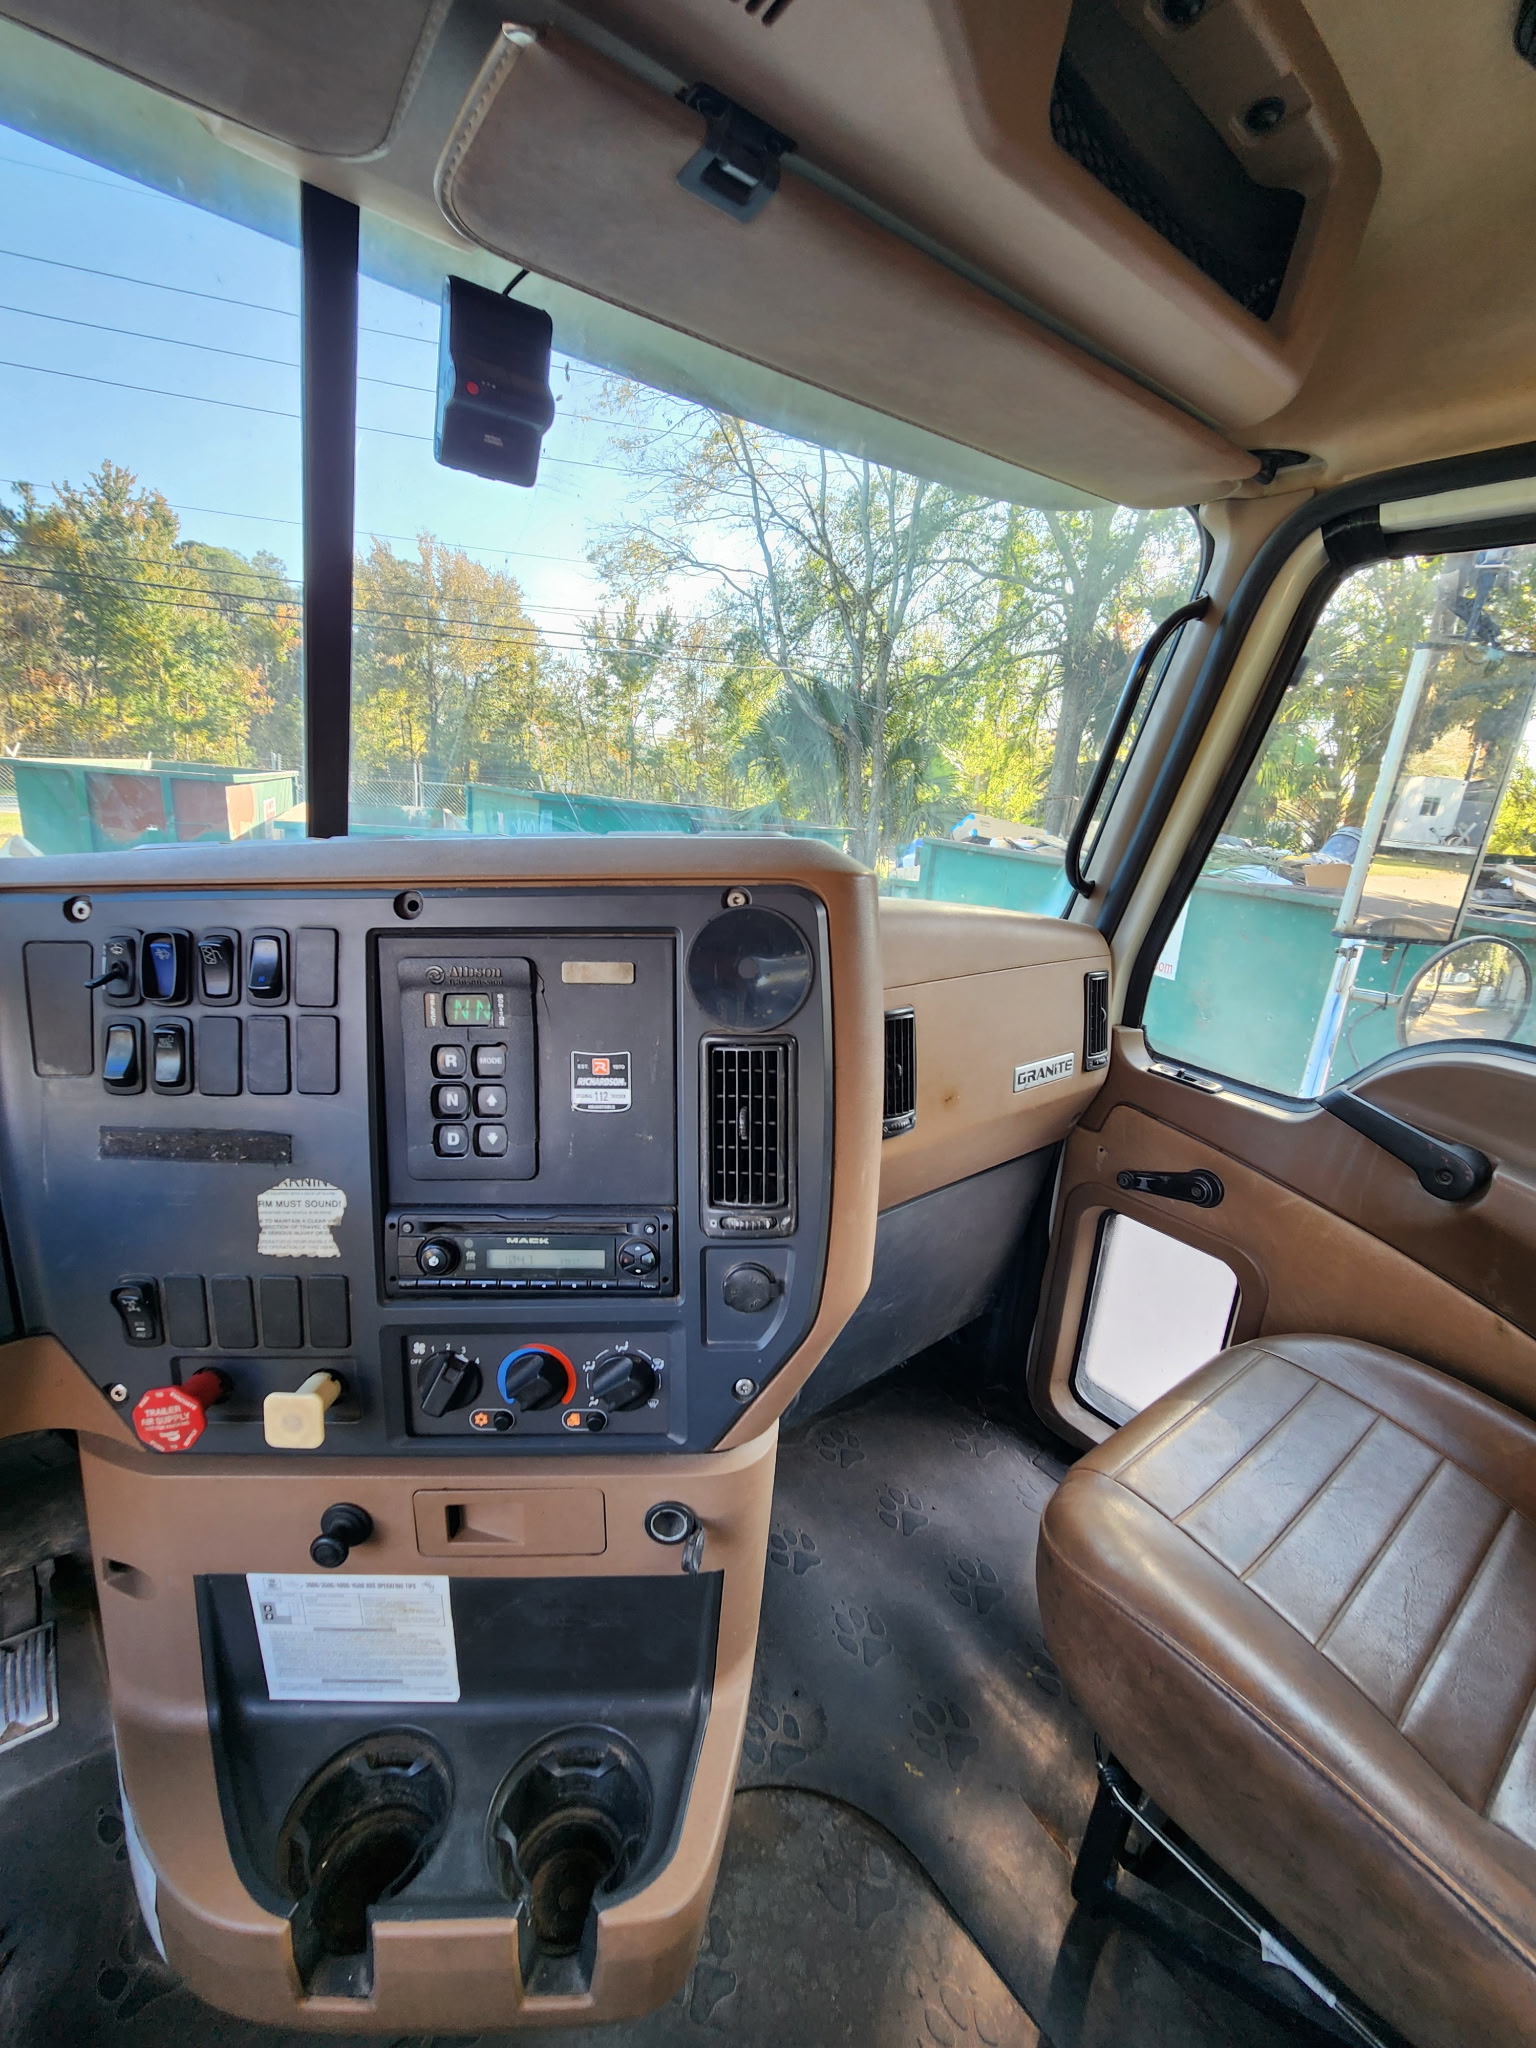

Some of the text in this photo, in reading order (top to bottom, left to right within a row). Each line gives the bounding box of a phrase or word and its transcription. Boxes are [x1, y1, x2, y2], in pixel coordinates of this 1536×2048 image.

[449, 966, 503, 977] Allison
[445, 1054, 458, 1068] R
[446, 1093, 459, 1107] N
[447, 1132, 460, 1146] D
[276, 1200, 302, 1208] MUST
[304, 1200, 342, 1208] SOUND!
[446, 1343, 451, 1351] 2
[461, 1346, 467, 1354] 3
[475, 1357, 480, 1365] 4
